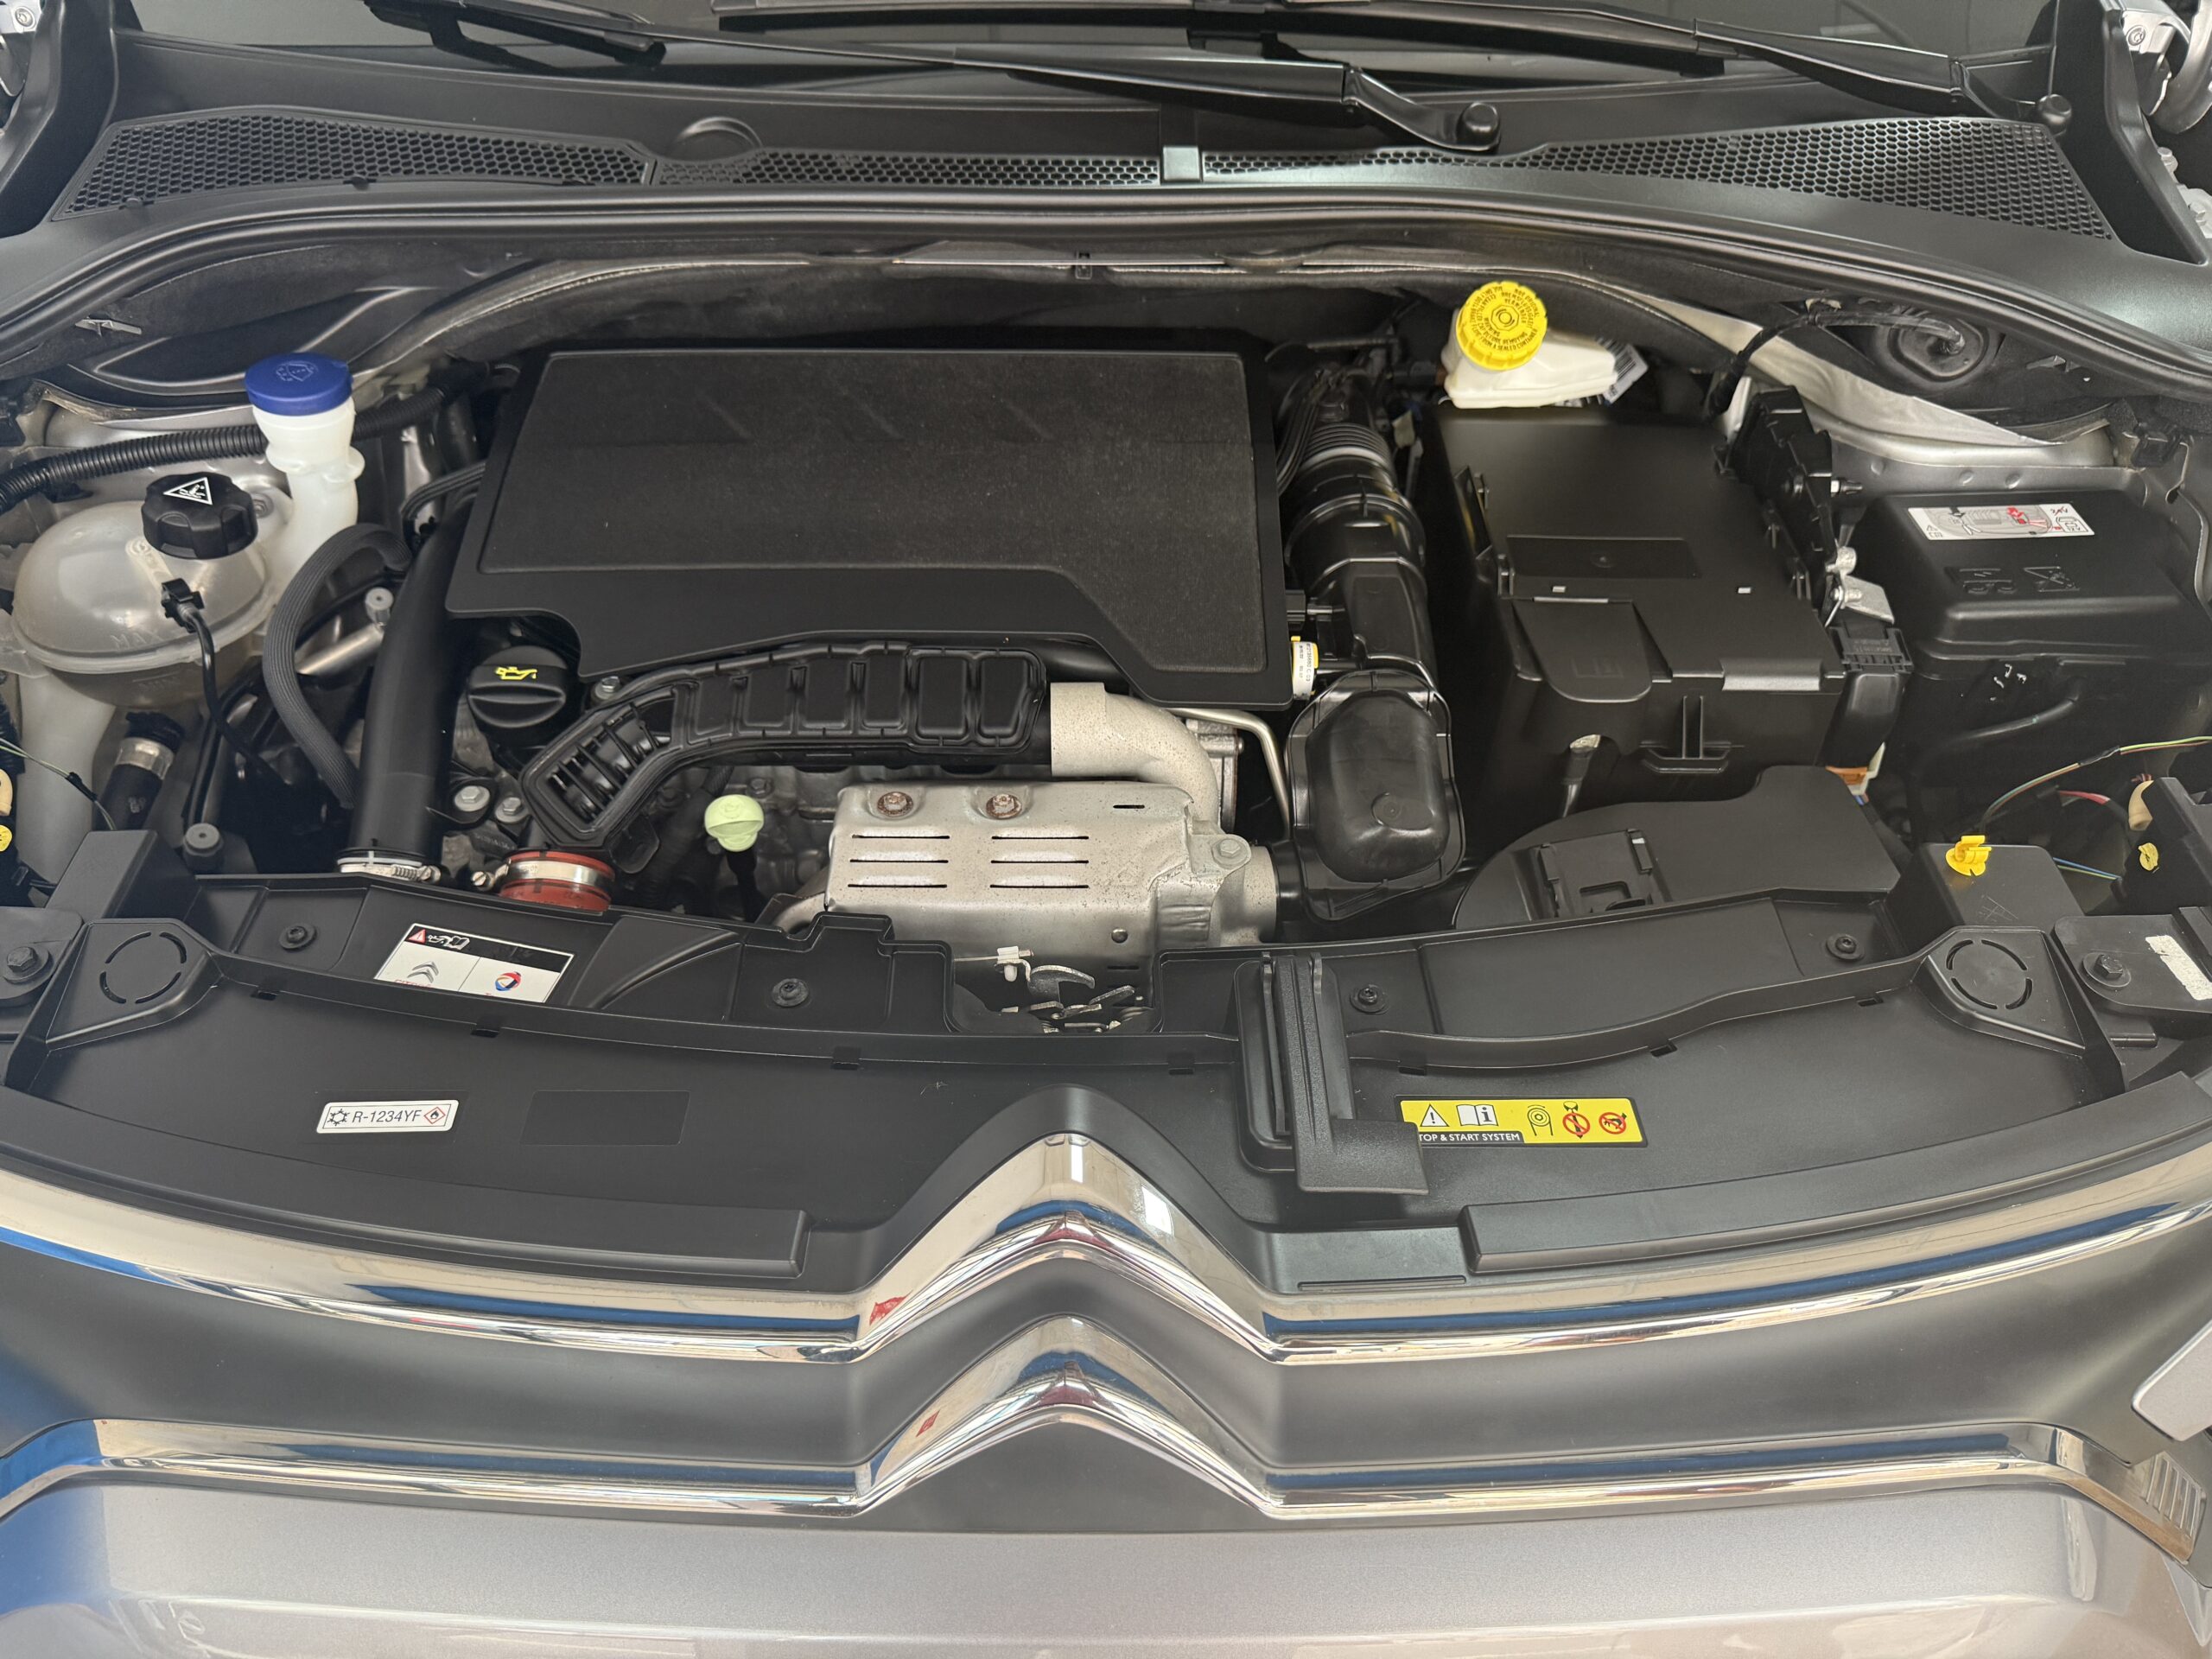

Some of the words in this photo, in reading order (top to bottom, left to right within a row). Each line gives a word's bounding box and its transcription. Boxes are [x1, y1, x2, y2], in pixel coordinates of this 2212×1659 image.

[1516, 327, 1536, 347] CONTAINER
[352, 1109, 422, 1123] R-1234YF
[1419, 1133, 1438, 1141] TOP
[1440, 1133, 1448, 1141] &
[1449, 1133, 1479, 1141] START
[1483, 1133, 1520, 1141] SYSTEM
